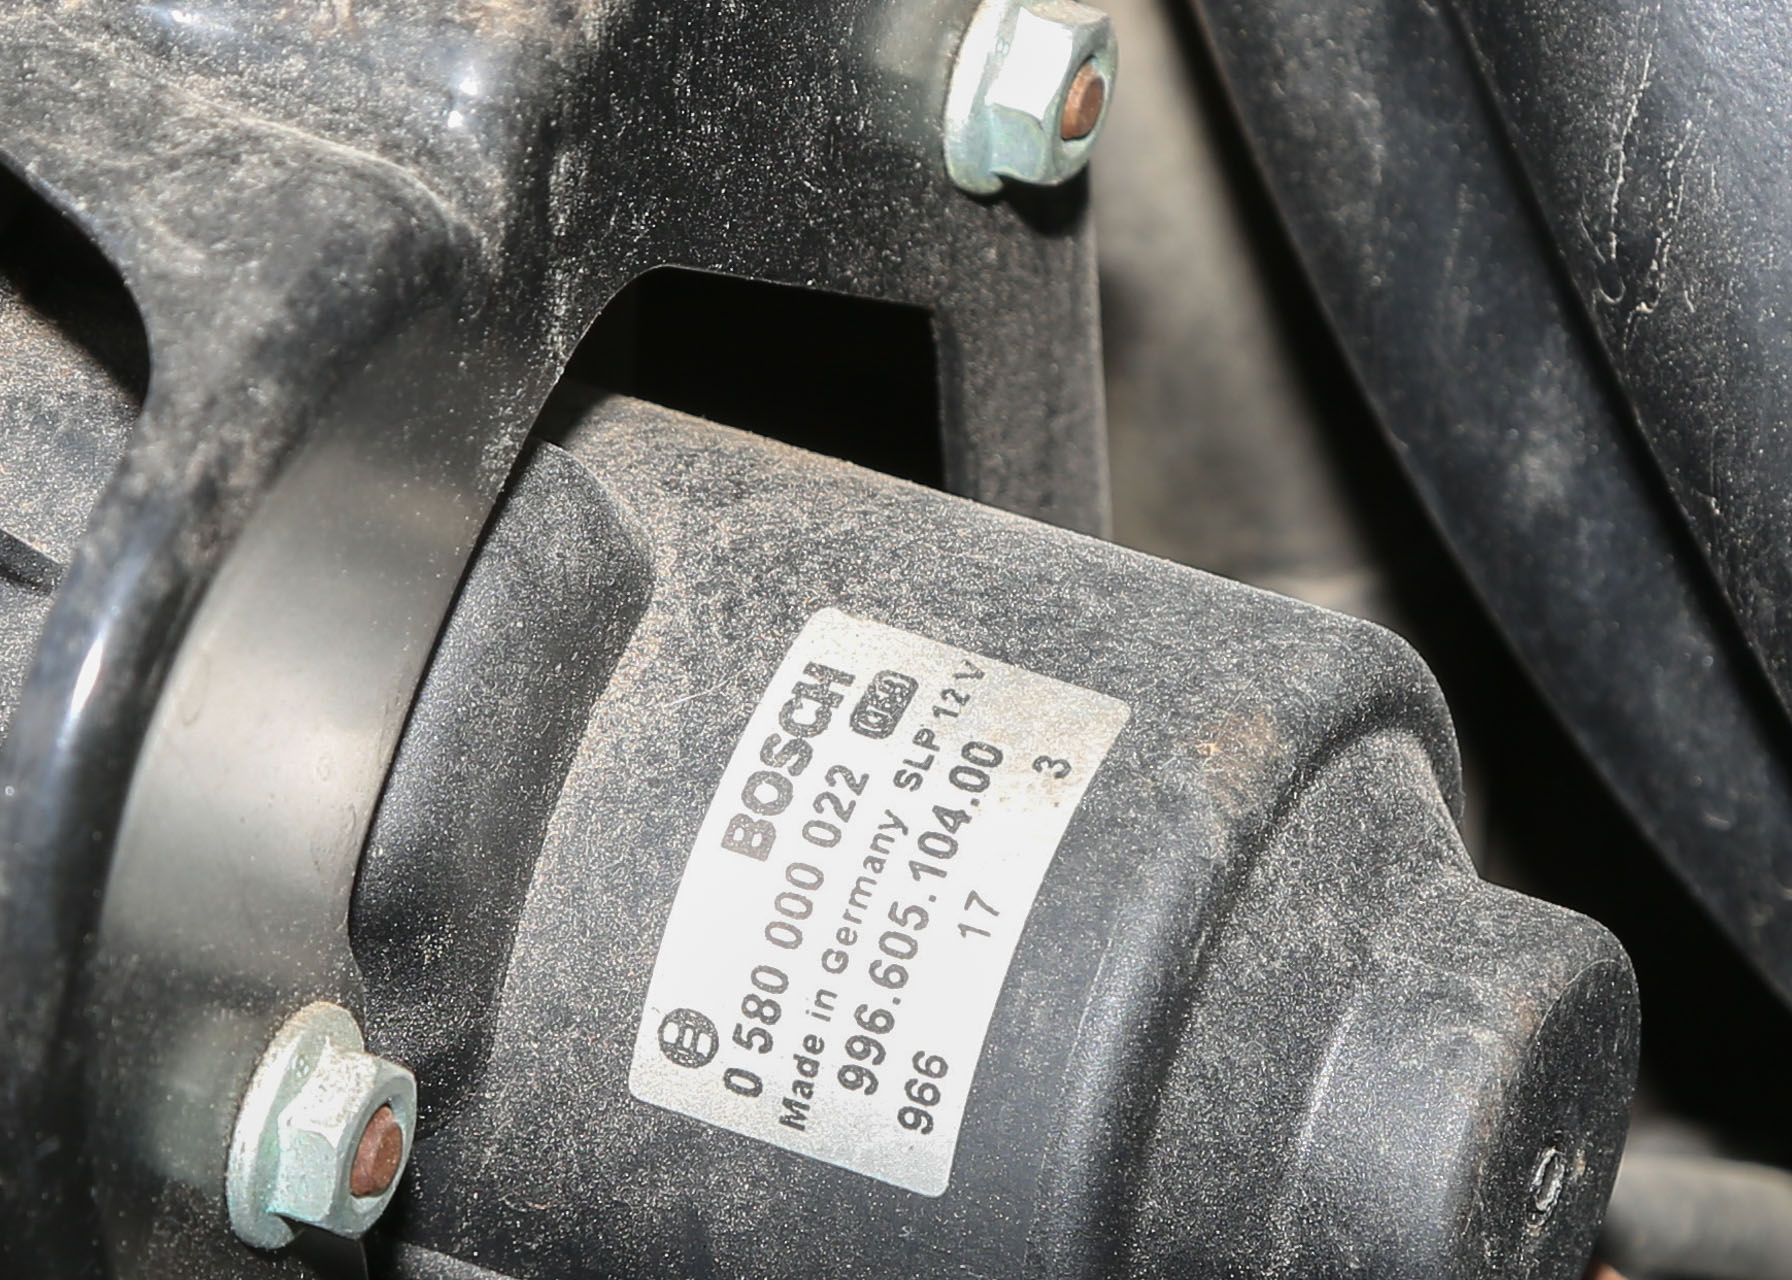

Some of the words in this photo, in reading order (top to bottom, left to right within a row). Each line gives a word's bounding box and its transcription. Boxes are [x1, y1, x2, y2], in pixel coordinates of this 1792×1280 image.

[932, 687, 971, 718] 12
[721, 662, 855, 861] BOSCH
[893, 727, 941, 791] SLP
[802, 765, 869, 847] 022
[765, 863, 824, 949] 000
[821, 809, 909, 974] Germany
[837, 741, 1003, 1096] 996.605.104.00
[897, 1051, 949, 1135] 966
[958, 891, 999, 937] 17
[1032, 755, 1072, 780] 3
[732, 965, 789, 1054] 580
[806, 988, 839, 1022] in
[722, 1067, 763, 1098] 0
[778, 1034, 825, 1132] Made
